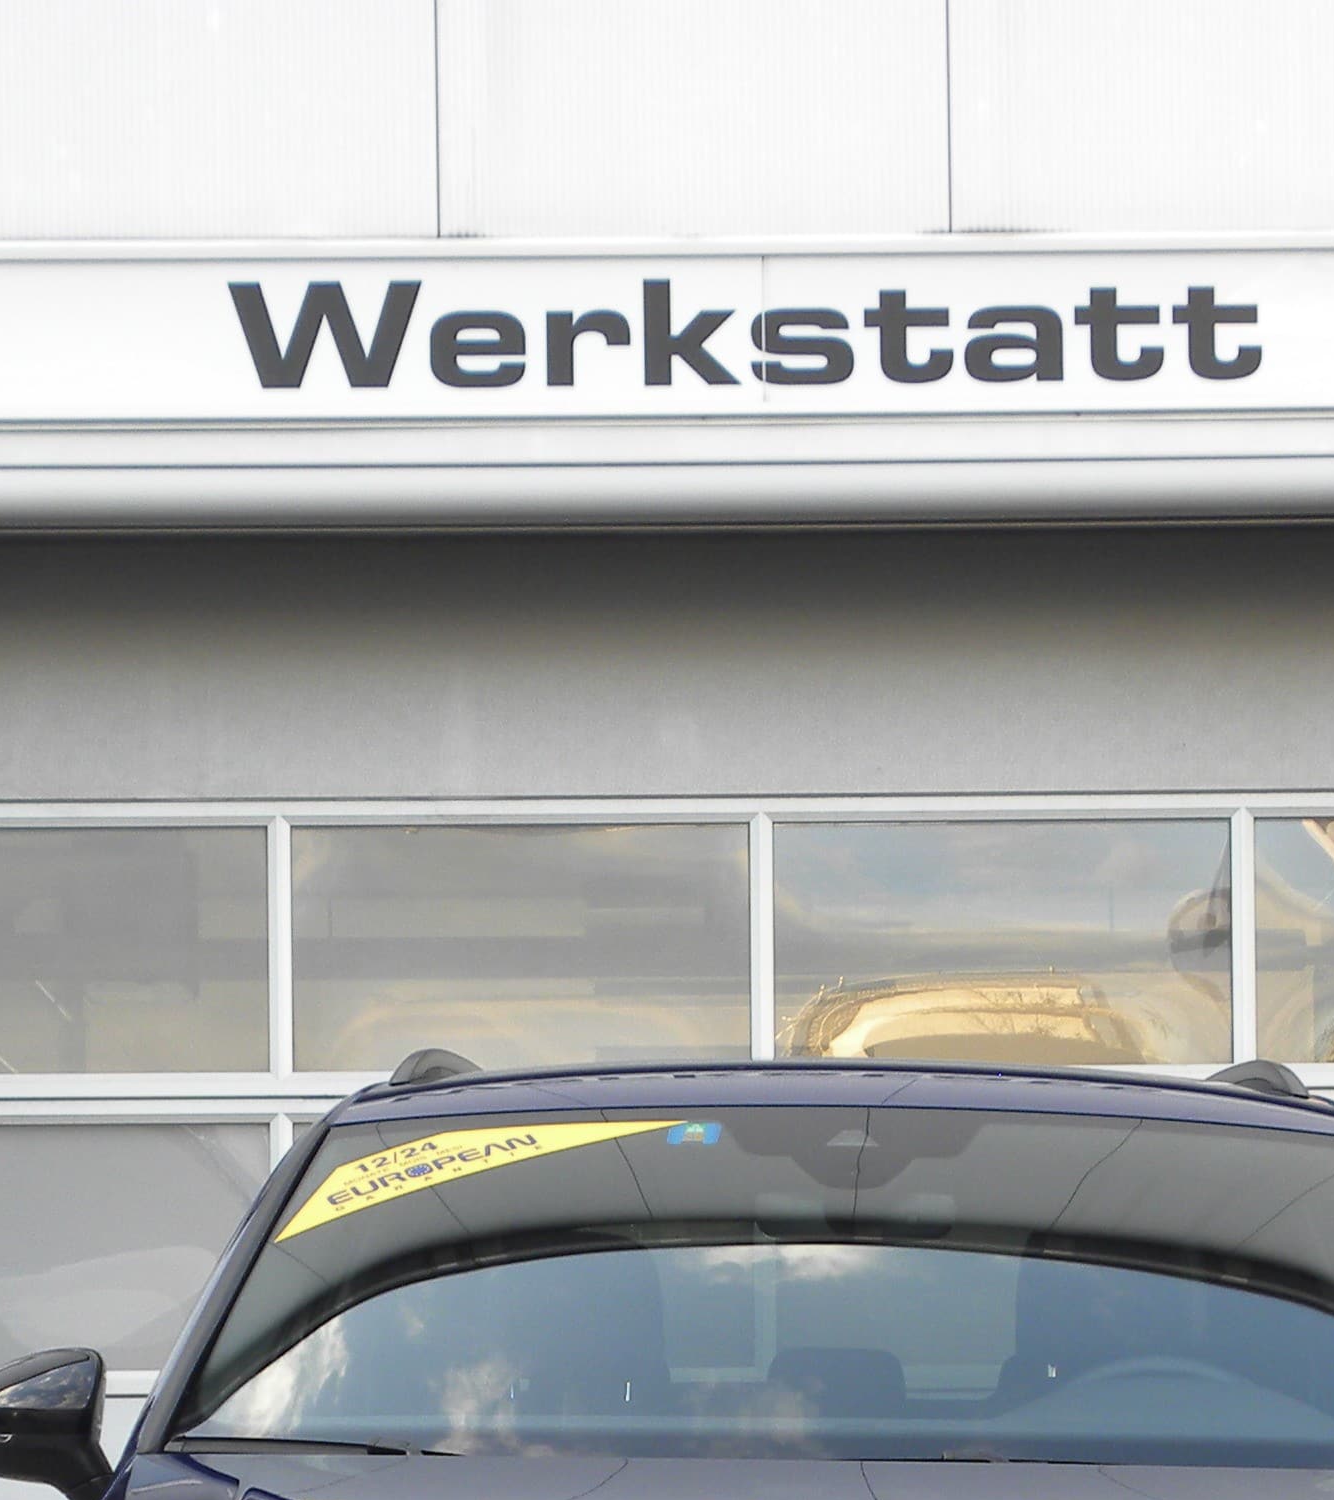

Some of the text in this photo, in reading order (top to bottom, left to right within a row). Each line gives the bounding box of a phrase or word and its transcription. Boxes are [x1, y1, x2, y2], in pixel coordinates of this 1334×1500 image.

[228, 278, 1263, 391] Werkstatt
[326, 1133, 538, 1206] EUROPEAN
[355, 1141, 439, 1173] 12/24
